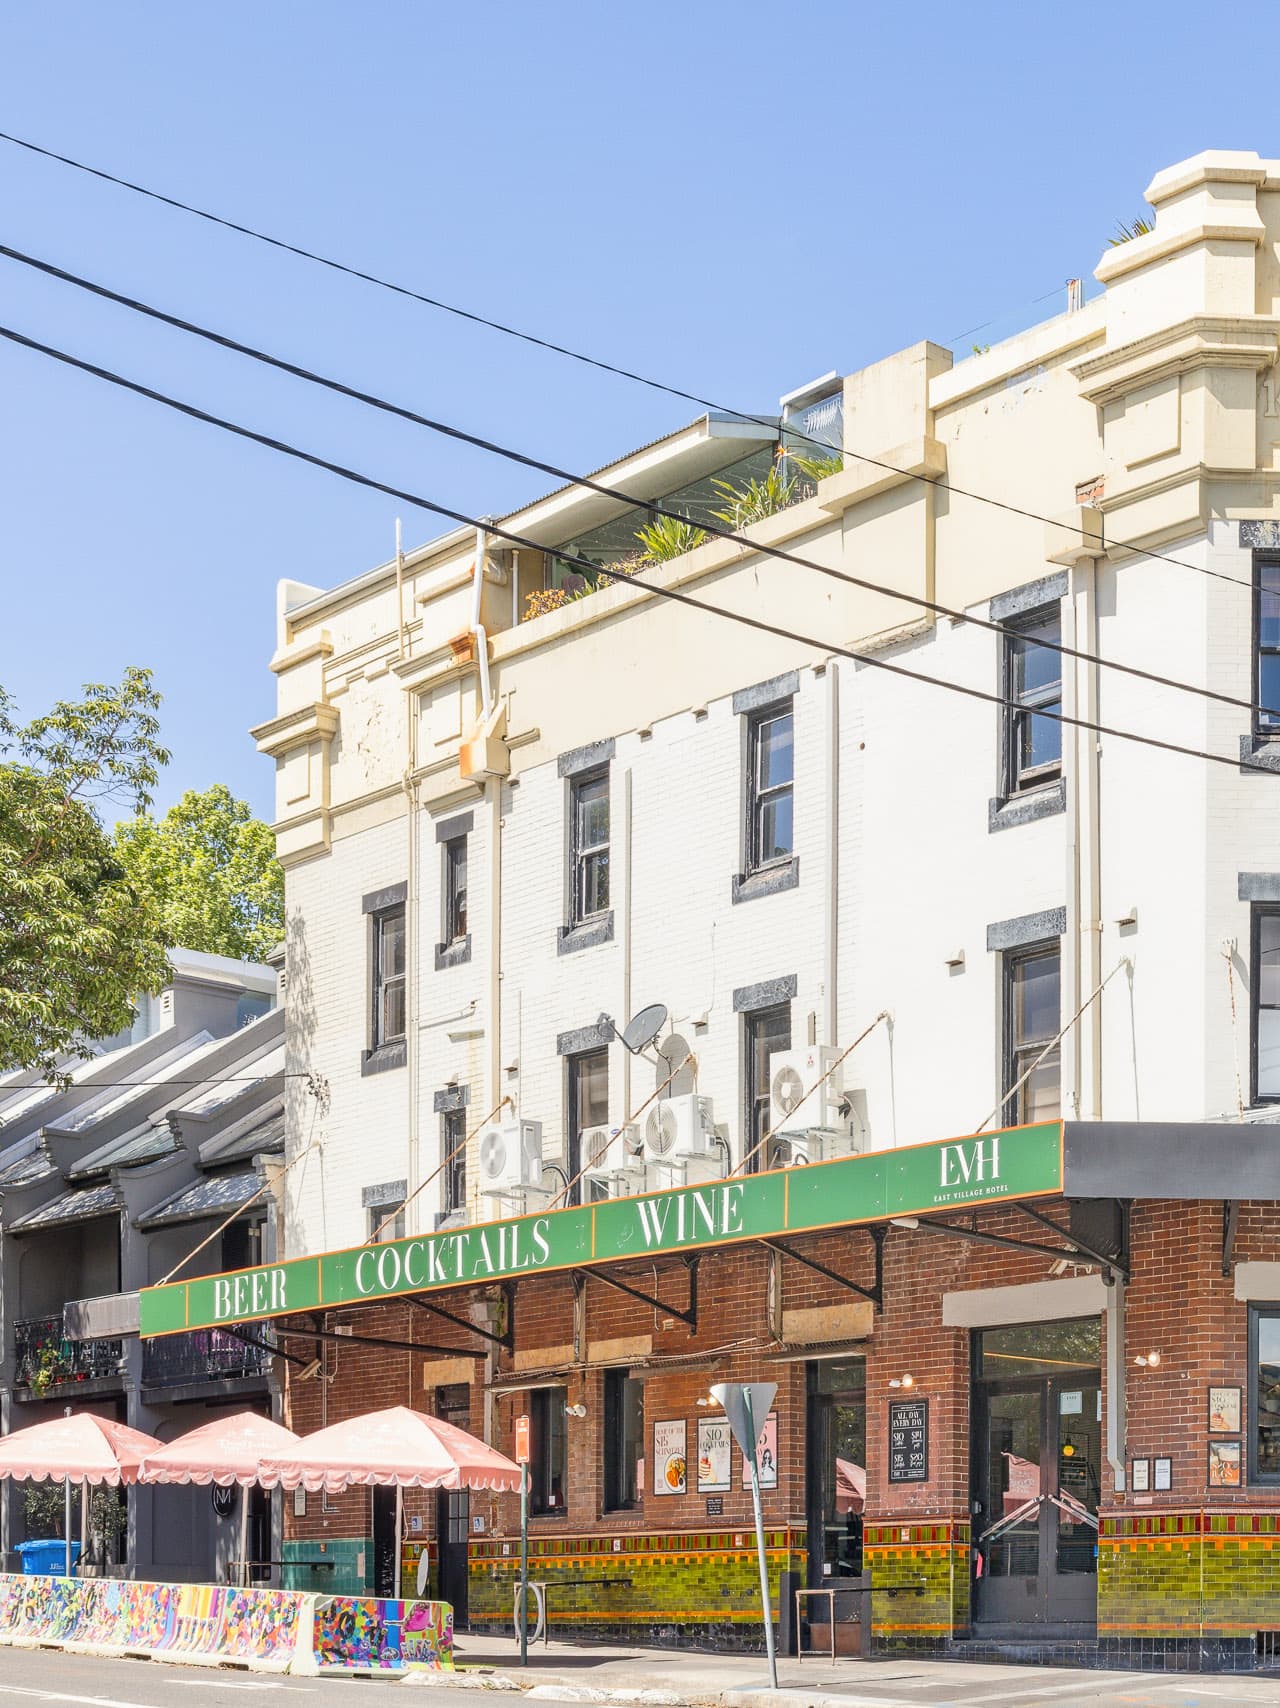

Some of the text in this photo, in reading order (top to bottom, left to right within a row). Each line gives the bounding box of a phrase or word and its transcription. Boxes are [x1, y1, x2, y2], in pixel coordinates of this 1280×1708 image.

[940, 1138, 1000, 1187] EVH
[636, 1184, 745, 1247] WINE
[934, 1185, 1009, 1203] EAST VILLAGE HOTEL
[355, 1218, 551, 1295] COCKTAILS
[214, 1269, 288, 1320] BEER
[706, 1428, 722, 1440] $10
[897, 1411, 919, 1420] ALL DAY
